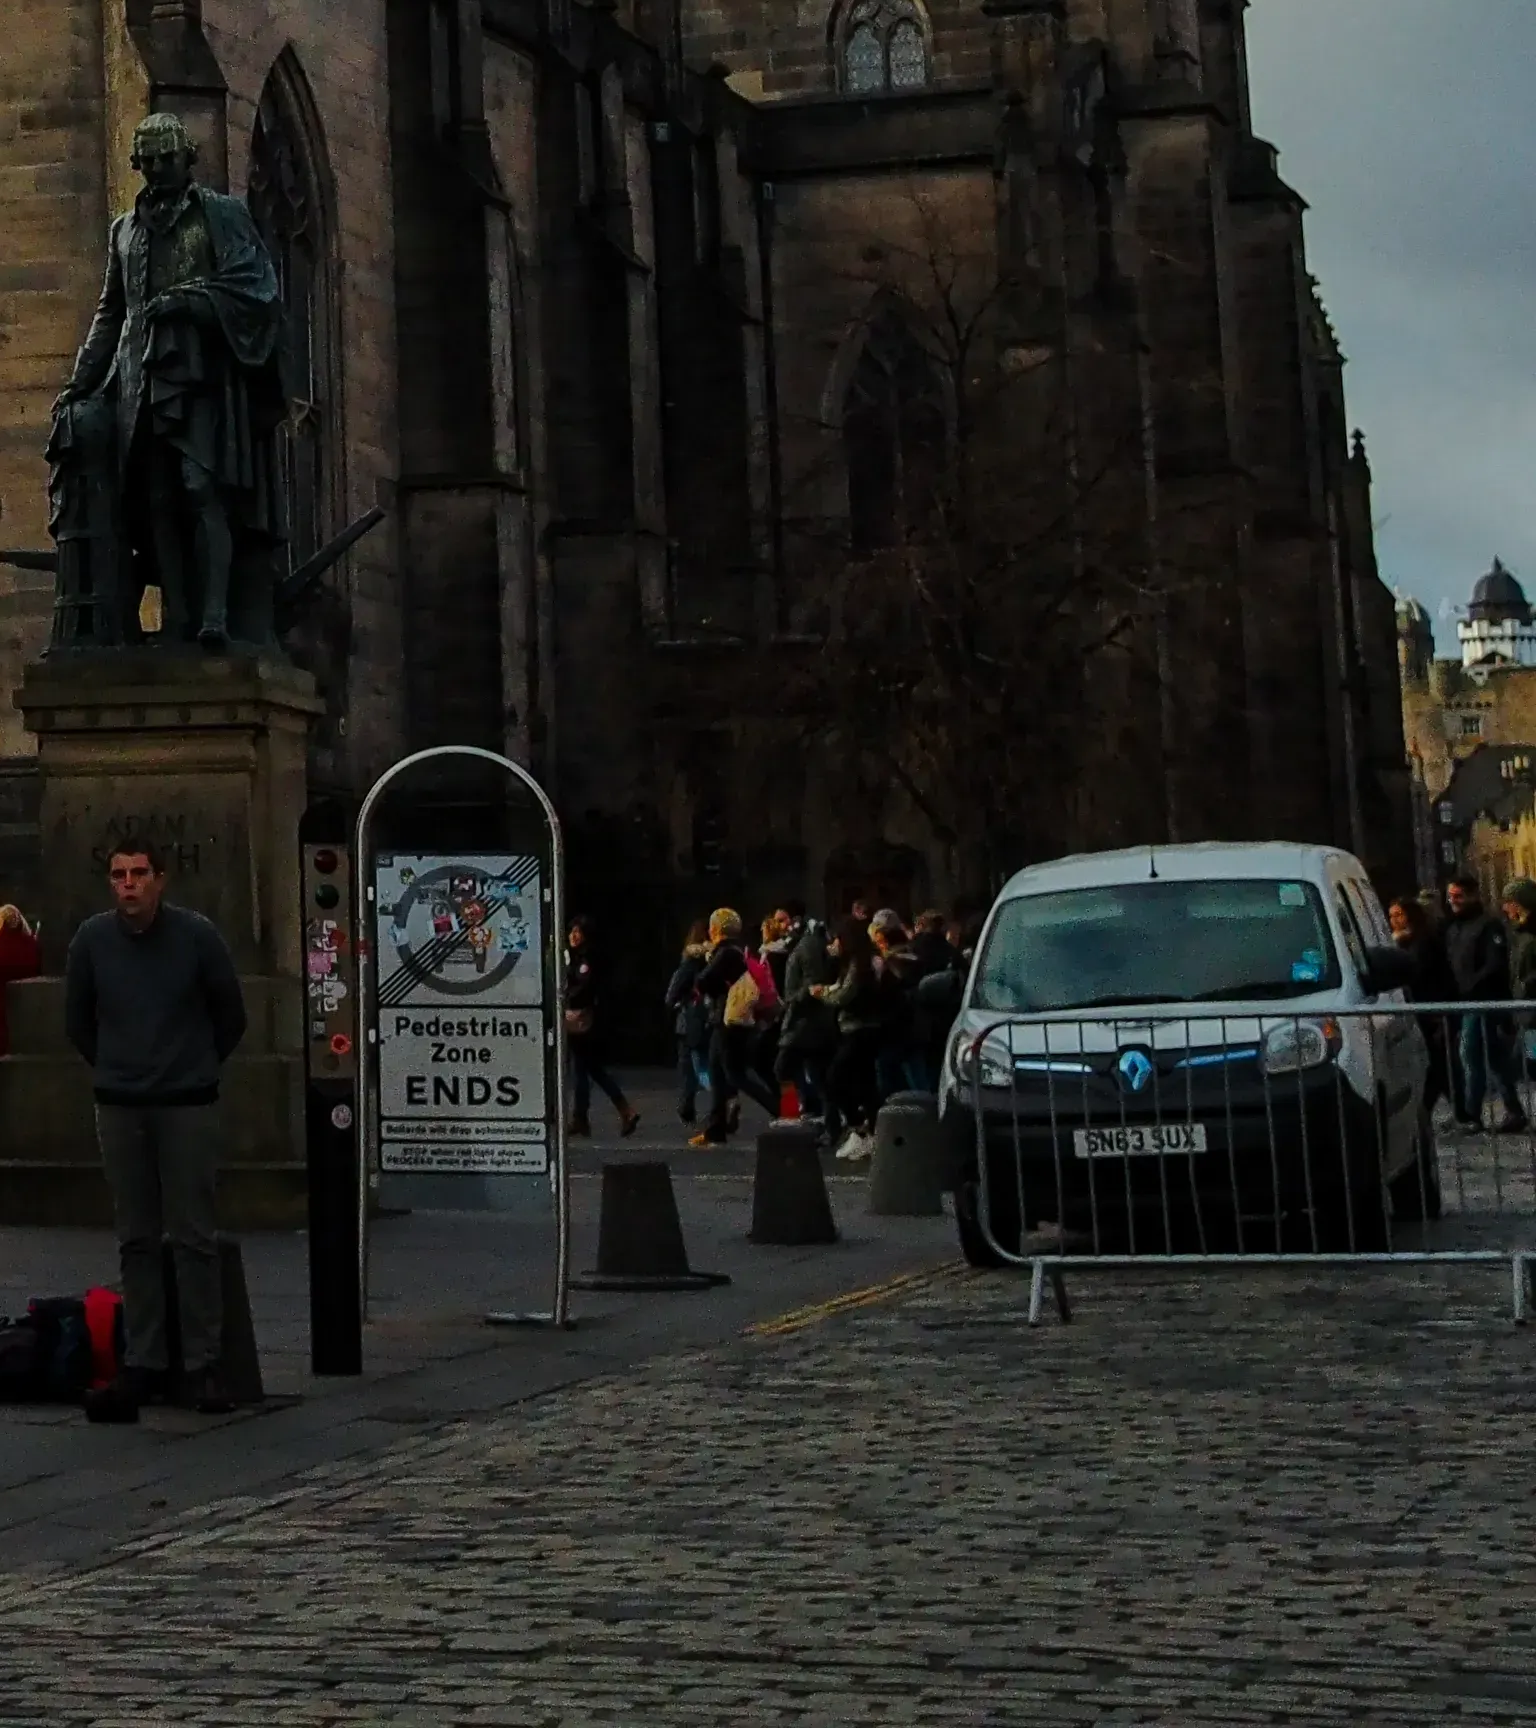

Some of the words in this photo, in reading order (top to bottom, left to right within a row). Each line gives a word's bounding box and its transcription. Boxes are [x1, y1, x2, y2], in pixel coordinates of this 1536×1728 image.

[105, 813, 186, 839] ADAM
[90, 843, 200, 878] STH
[395, 1016, 529, 1038] Pedestrian
[430, 1042, 492, 1064] Zone
[406, 1075, 521, 1107] ENDS
[386, 1124, 427, 1135] Bollards
[429, 1125, 447, 1135] will
[450, 1125, 472, 1136] drop
[474, 1125, 541, 1137] automatically
[386, 1156, 433, 1165] PROCEED
[436, 1158, 460, 1166] when
[462, 1157, 488, 1167] green
[489, 1157, 511, 1167] light
[514, 1158, 541, 1166] shows
[402, 1147, 428, 1156] STOP
[430, 1148, 455, 1156] when
[456, 1148, 472, 1156] red
[474, 1148, 495, 1158] light
[497, 1148, 526, 1157] shows
